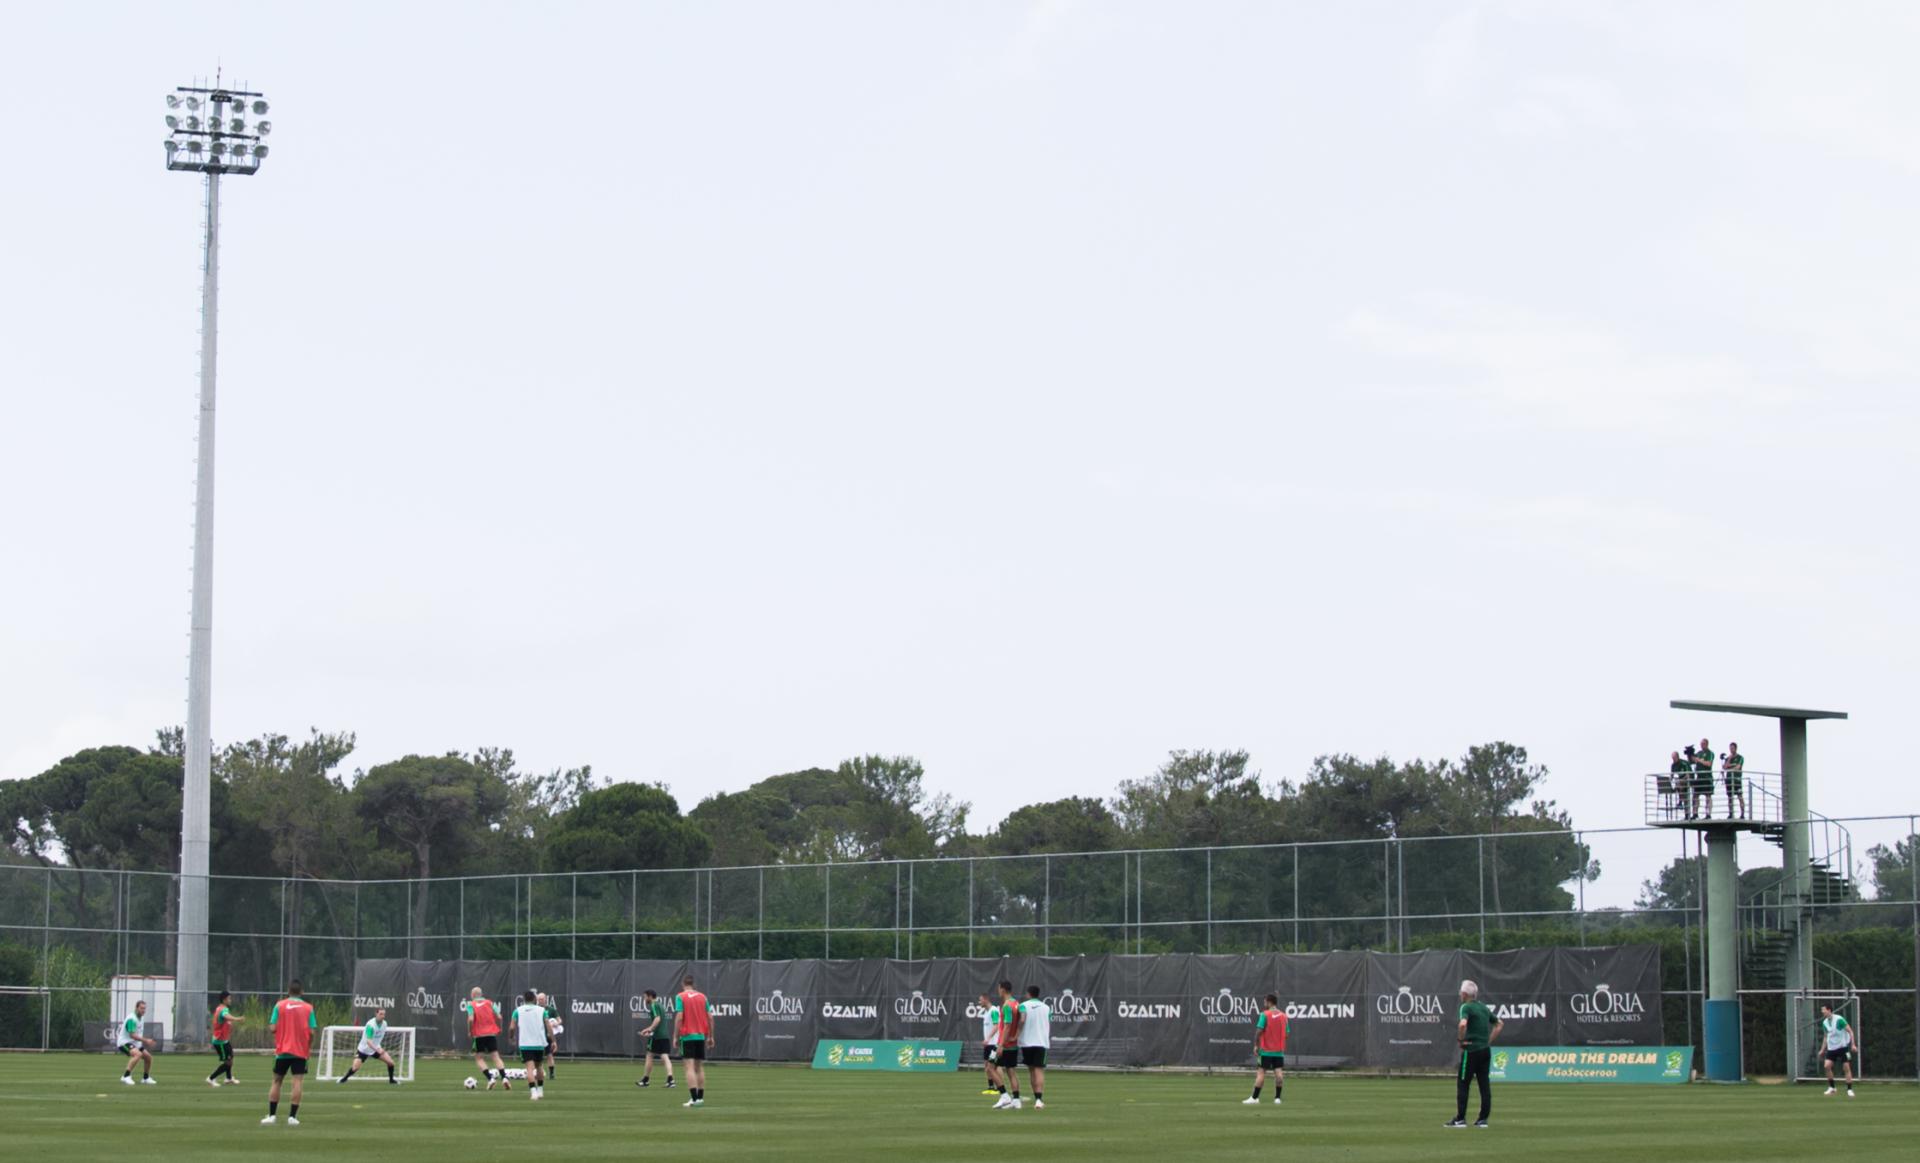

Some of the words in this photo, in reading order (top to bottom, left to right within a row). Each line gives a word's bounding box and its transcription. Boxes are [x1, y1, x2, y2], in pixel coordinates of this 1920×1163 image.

[354, 994, 395, 1008] ÖZALTIN
[571, 999, 615, 1014] ÖZALTIN
[756, 993, 804, 1014] GLORIA
[895, 994, 948, 1015] GLORIA
[1200, 992, 1260, 1015] GLORIA
[1376, 990, 1444, 1015] GLORIA
[1570, 988, 1646, 1014] GLORIA
[709, 1004, 742, 1016] ALTIN
[822, 1002, 877, 1018] ÖZALTIN
[1118, 1001, 1180, 1018] ÖZALTIN
[1285, 1001, 1355, 1018] ÖZALTIN
[1230, 1015, 1252, 1024] ARENA
[1576, 1014, 1602, 1023] HOTELS
[1610, 1013, 1641, 1023] RESORTS
[1517, 1052, 1577, 1065] HONOUR
[1580, 1052, 1606, 1064] THE
[1608, 1052, 1657, 1064] DREAM
[1547, 1066, 1617, 1078] #GoSocceroos
